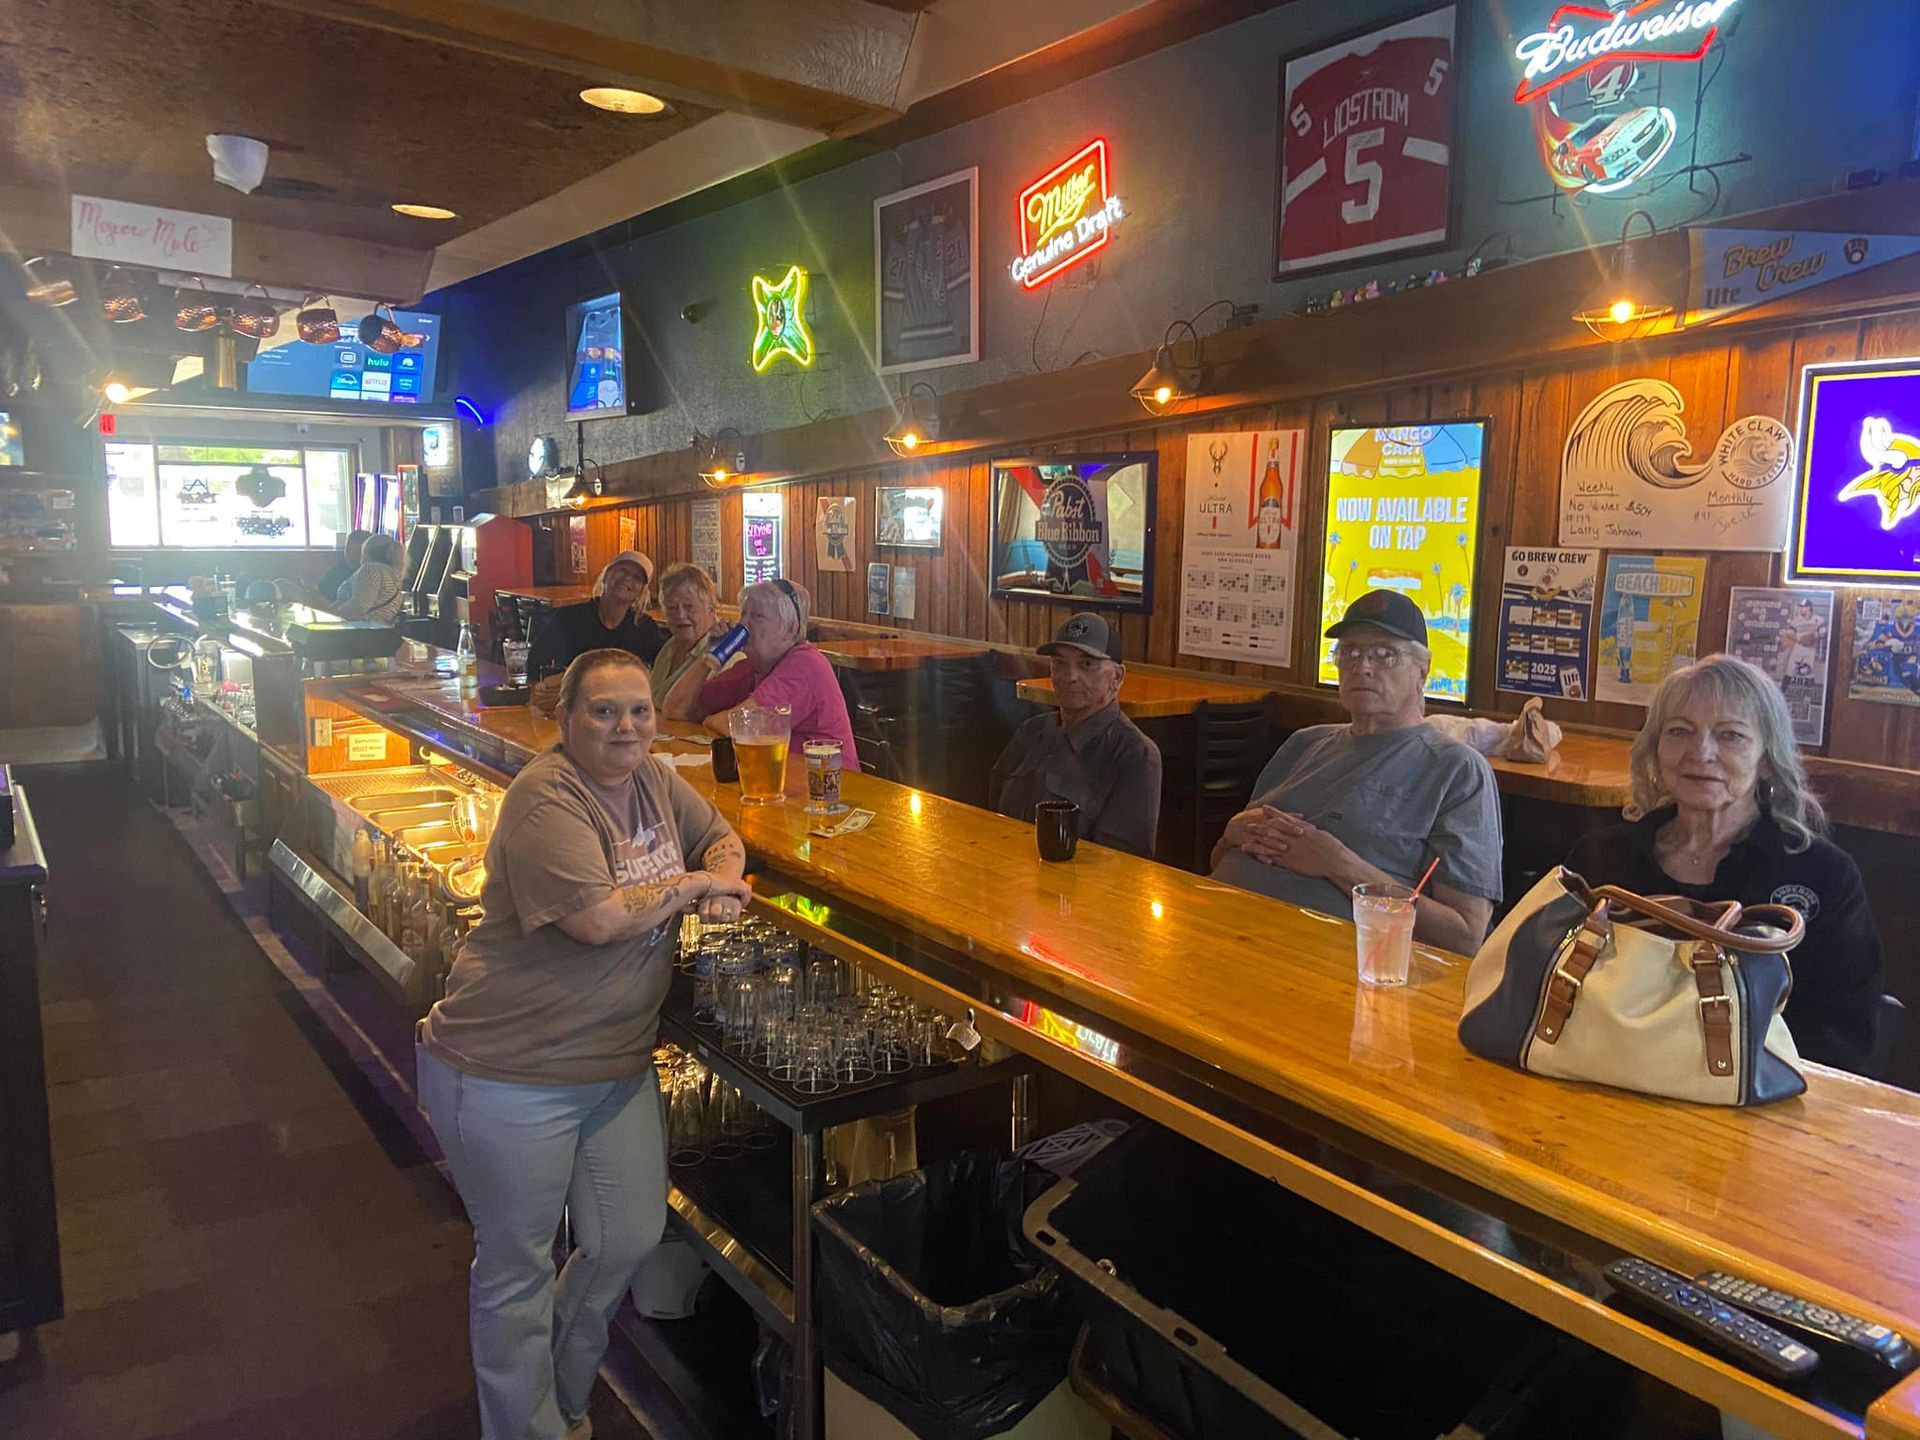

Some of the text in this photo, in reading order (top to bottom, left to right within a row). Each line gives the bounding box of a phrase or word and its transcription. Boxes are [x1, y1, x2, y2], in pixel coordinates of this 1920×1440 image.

[1515, 0, 1738, 79] Budweiser
[1424, 58, 1448, 96] 5
[1590, 64, 1623, 106] 4
[1290, 103, 1312, 136] 5
[1341, 127, 1385, 224] 5
[1027, 164, 1095, 240] Miller
[1012, 195, 1123, 281] Genuine Draft
[1723, 234, 1795, 279] Brew
[1755, 252, 1827, 292] Crew
[367, 357, 389, 367] hulu
[1374, 428, 1433, 442] MANGO
[1718, 420, 1785, 467] WHITE CLAW
[1381, 443, 1420, 456] CART
[1728, 472, 1752, 487] HARD
[1050, 490, 1085, 520] Pabst
[1199, 503, 1233, 514] ULTRA
[1336, 496, 1469, 523] NOW AVAILABLE
[1707, 490, 1753, 506] Monthly
[1037, 521, 1100, 542] Blue Ribbon
[1369, 524, 1427, 550] ON TAP
[1511, 551, 1587, 564] GO BREW CREW
[1531, 662, 1557, 675] 2025
